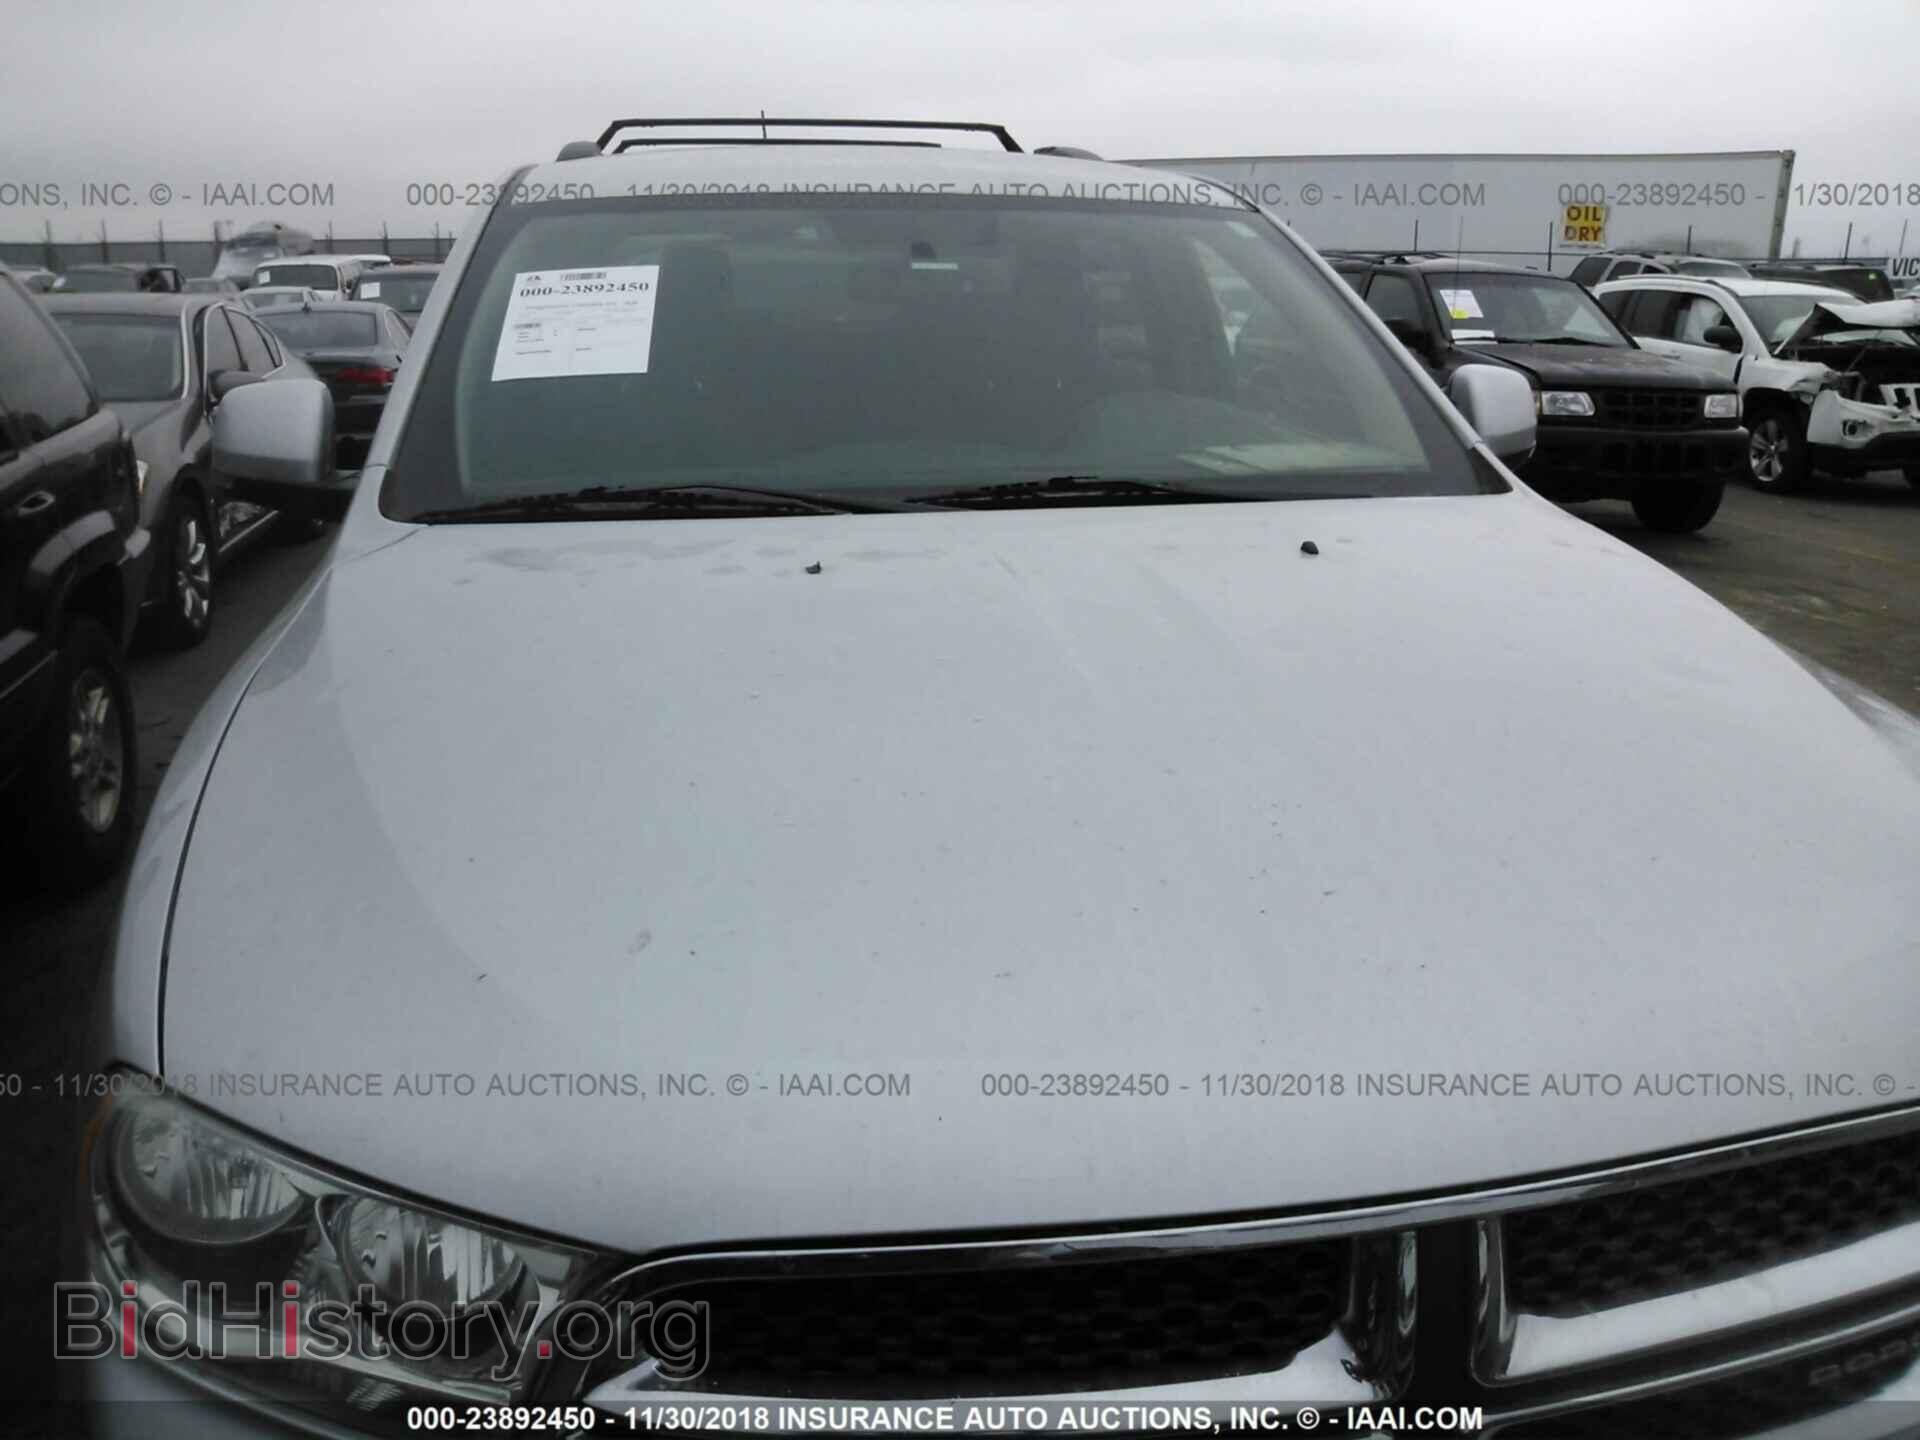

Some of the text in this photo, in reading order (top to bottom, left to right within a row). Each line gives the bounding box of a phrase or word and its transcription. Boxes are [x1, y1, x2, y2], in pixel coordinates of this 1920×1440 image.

[1567, 206, 1601, 221] OIL
[1564, 225, 1602, 241] DRY
[1892, 258, 1920, 276] VIC
[519, 282, 650, 297] 000-23892450
